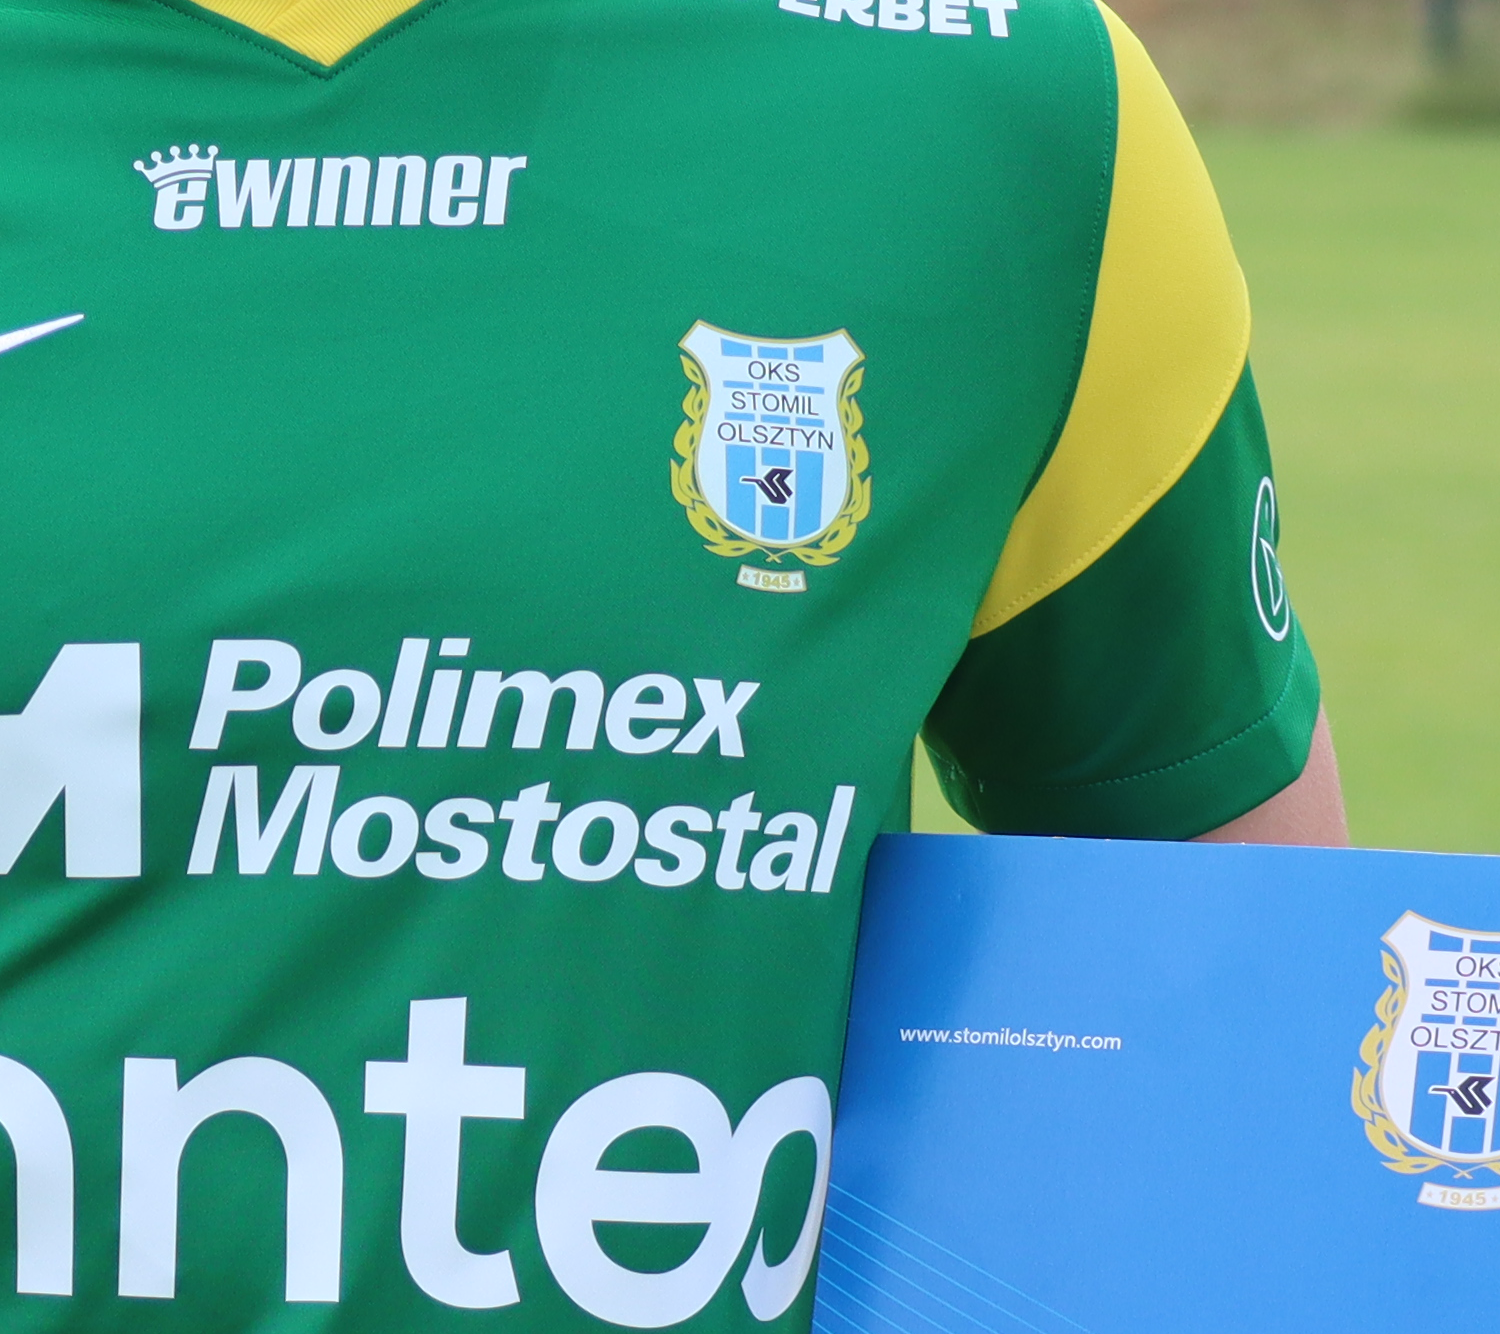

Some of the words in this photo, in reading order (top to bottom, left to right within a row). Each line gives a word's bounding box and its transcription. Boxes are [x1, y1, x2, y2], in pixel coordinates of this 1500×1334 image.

[747, 360, 801, 384] OKS
[730, 389, 820, 417] STOMIL
[716, 422, 835, 451] OLSZTYN
[752, 571, 791, 589] 1945
[188, 637, 760, 758] Polimex
[187, 764, 856, 894] Mostostal
[899, 1027, 1122, 1051] www.stomilolsztyn.com
[1438, 1189, 1487, 1206] 1945
